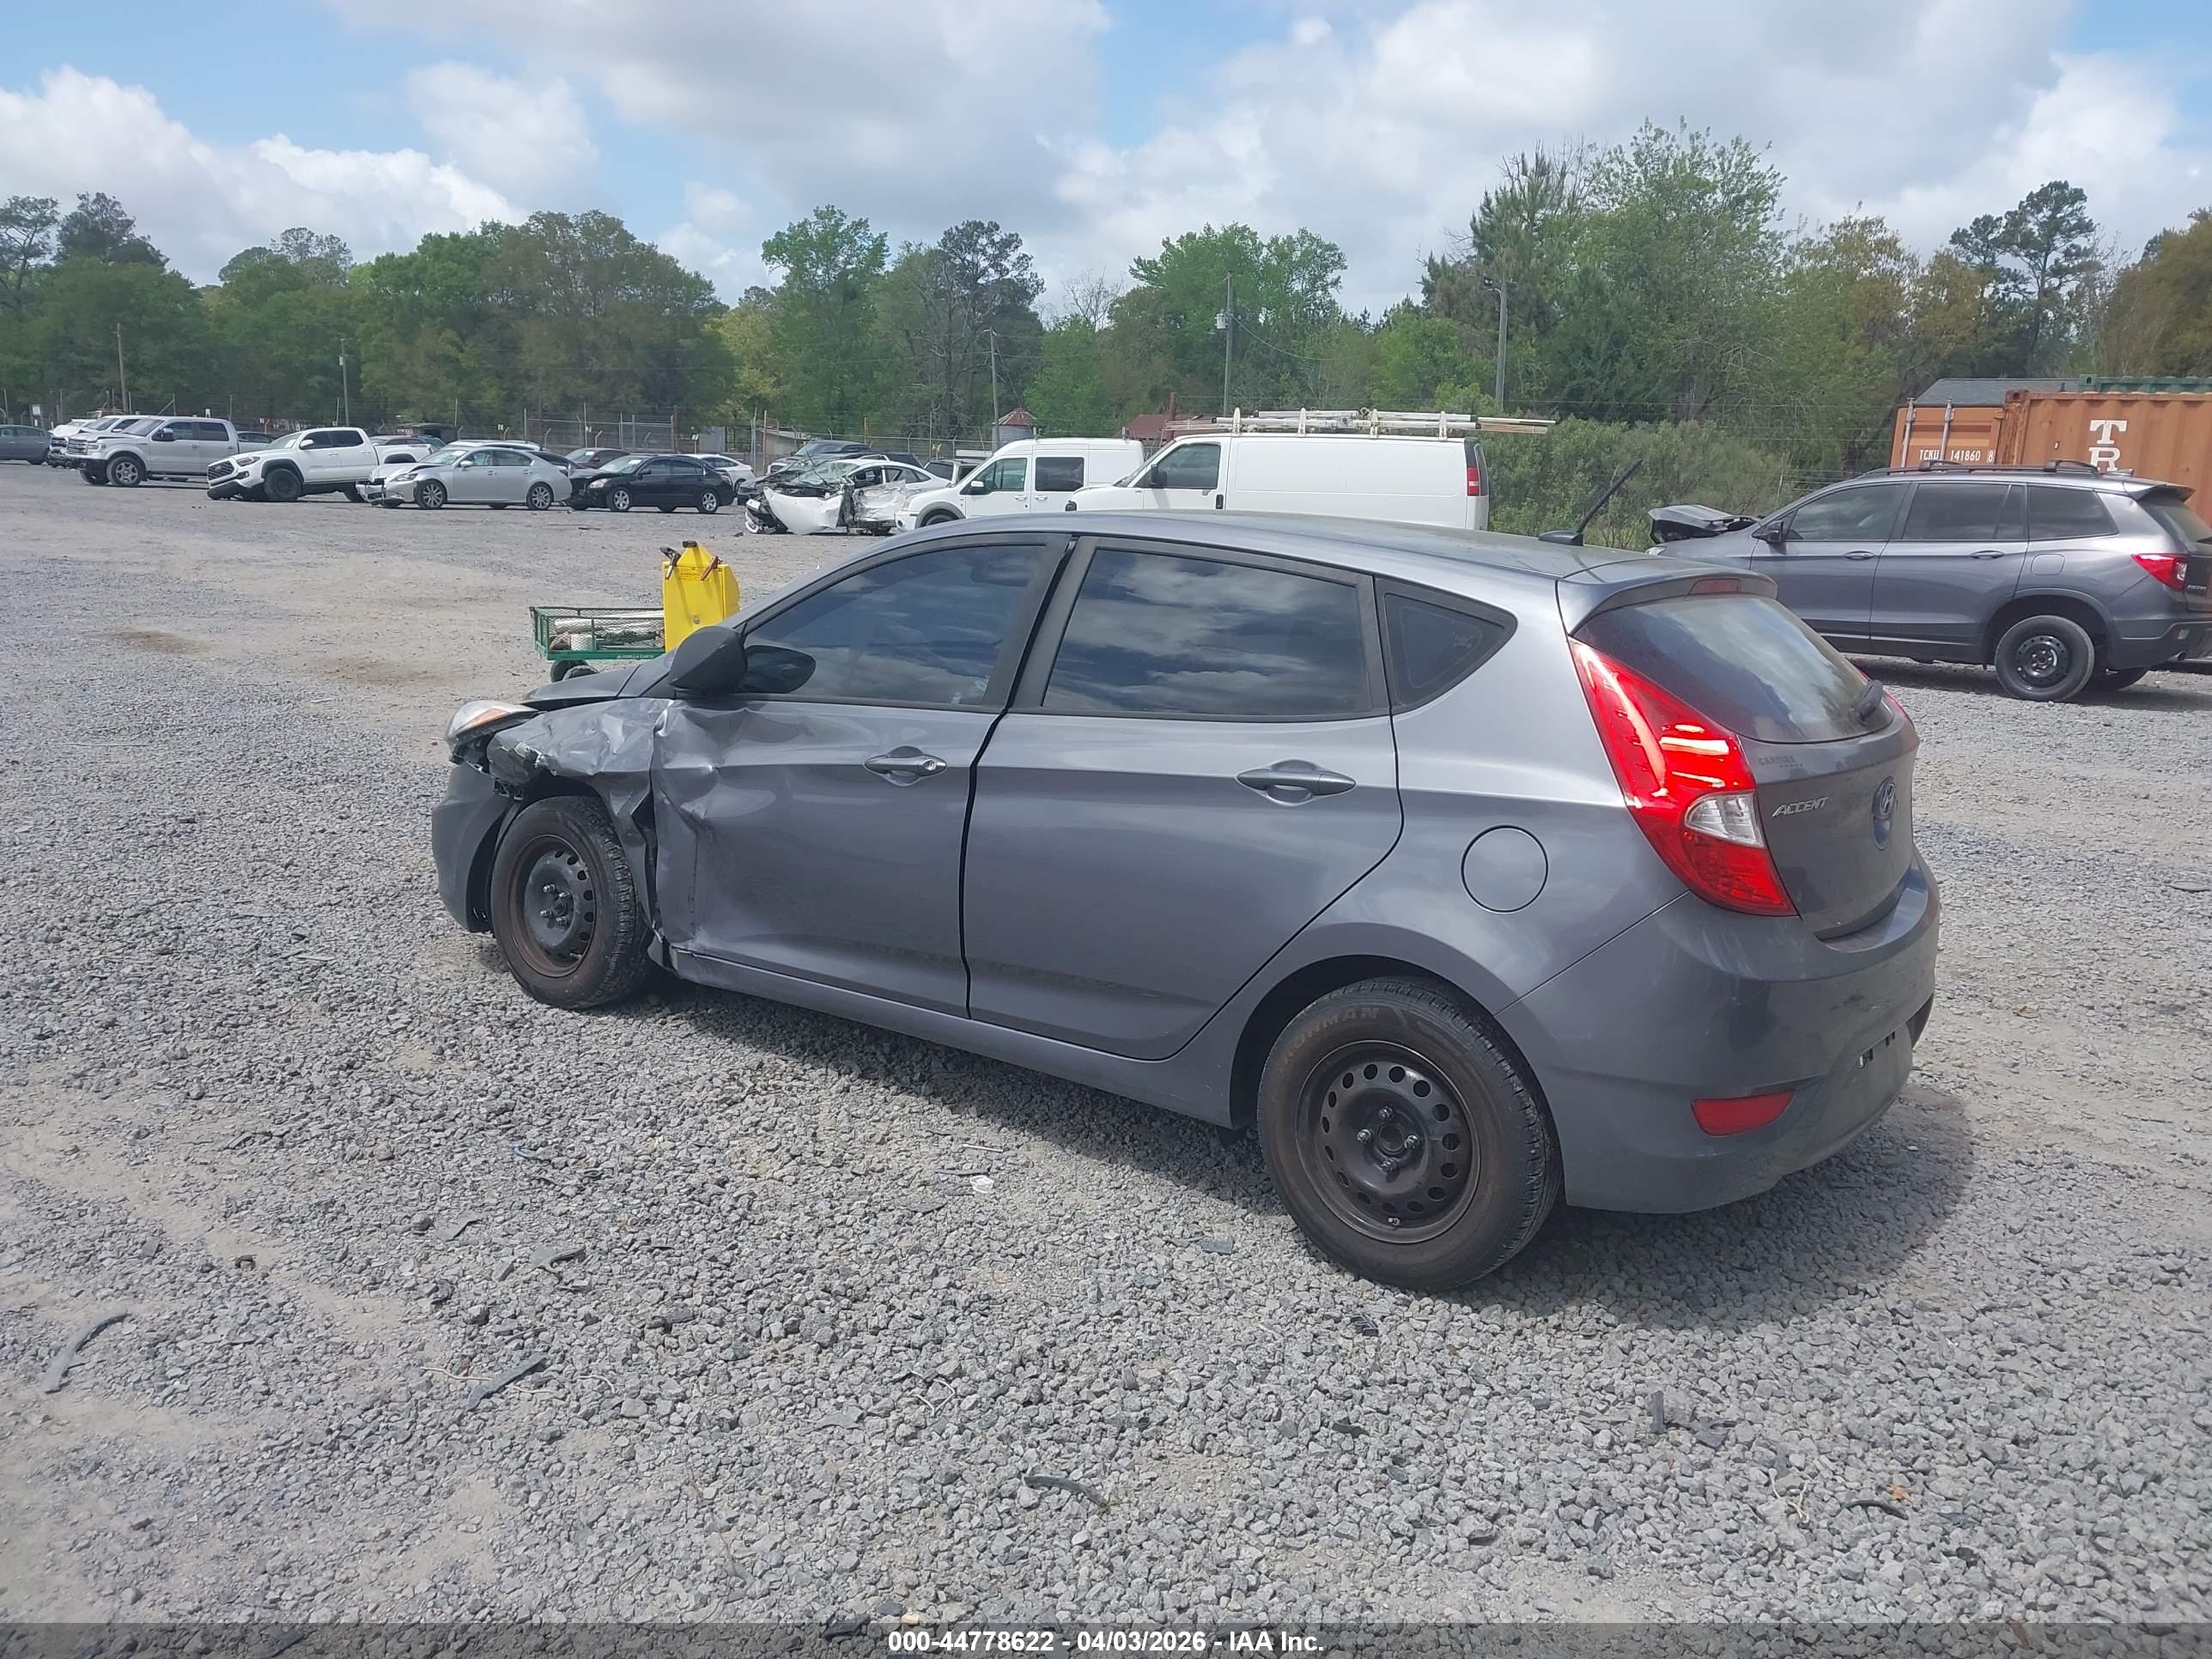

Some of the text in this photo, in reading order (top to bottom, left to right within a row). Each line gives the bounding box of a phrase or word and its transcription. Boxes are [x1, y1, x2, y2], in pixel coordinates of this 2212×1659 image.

[1919, 449, 1940, 460] TCKU
[1950, 449, 1981, 461] 141860
[1771, 796, 1830, 817] ACCENT
